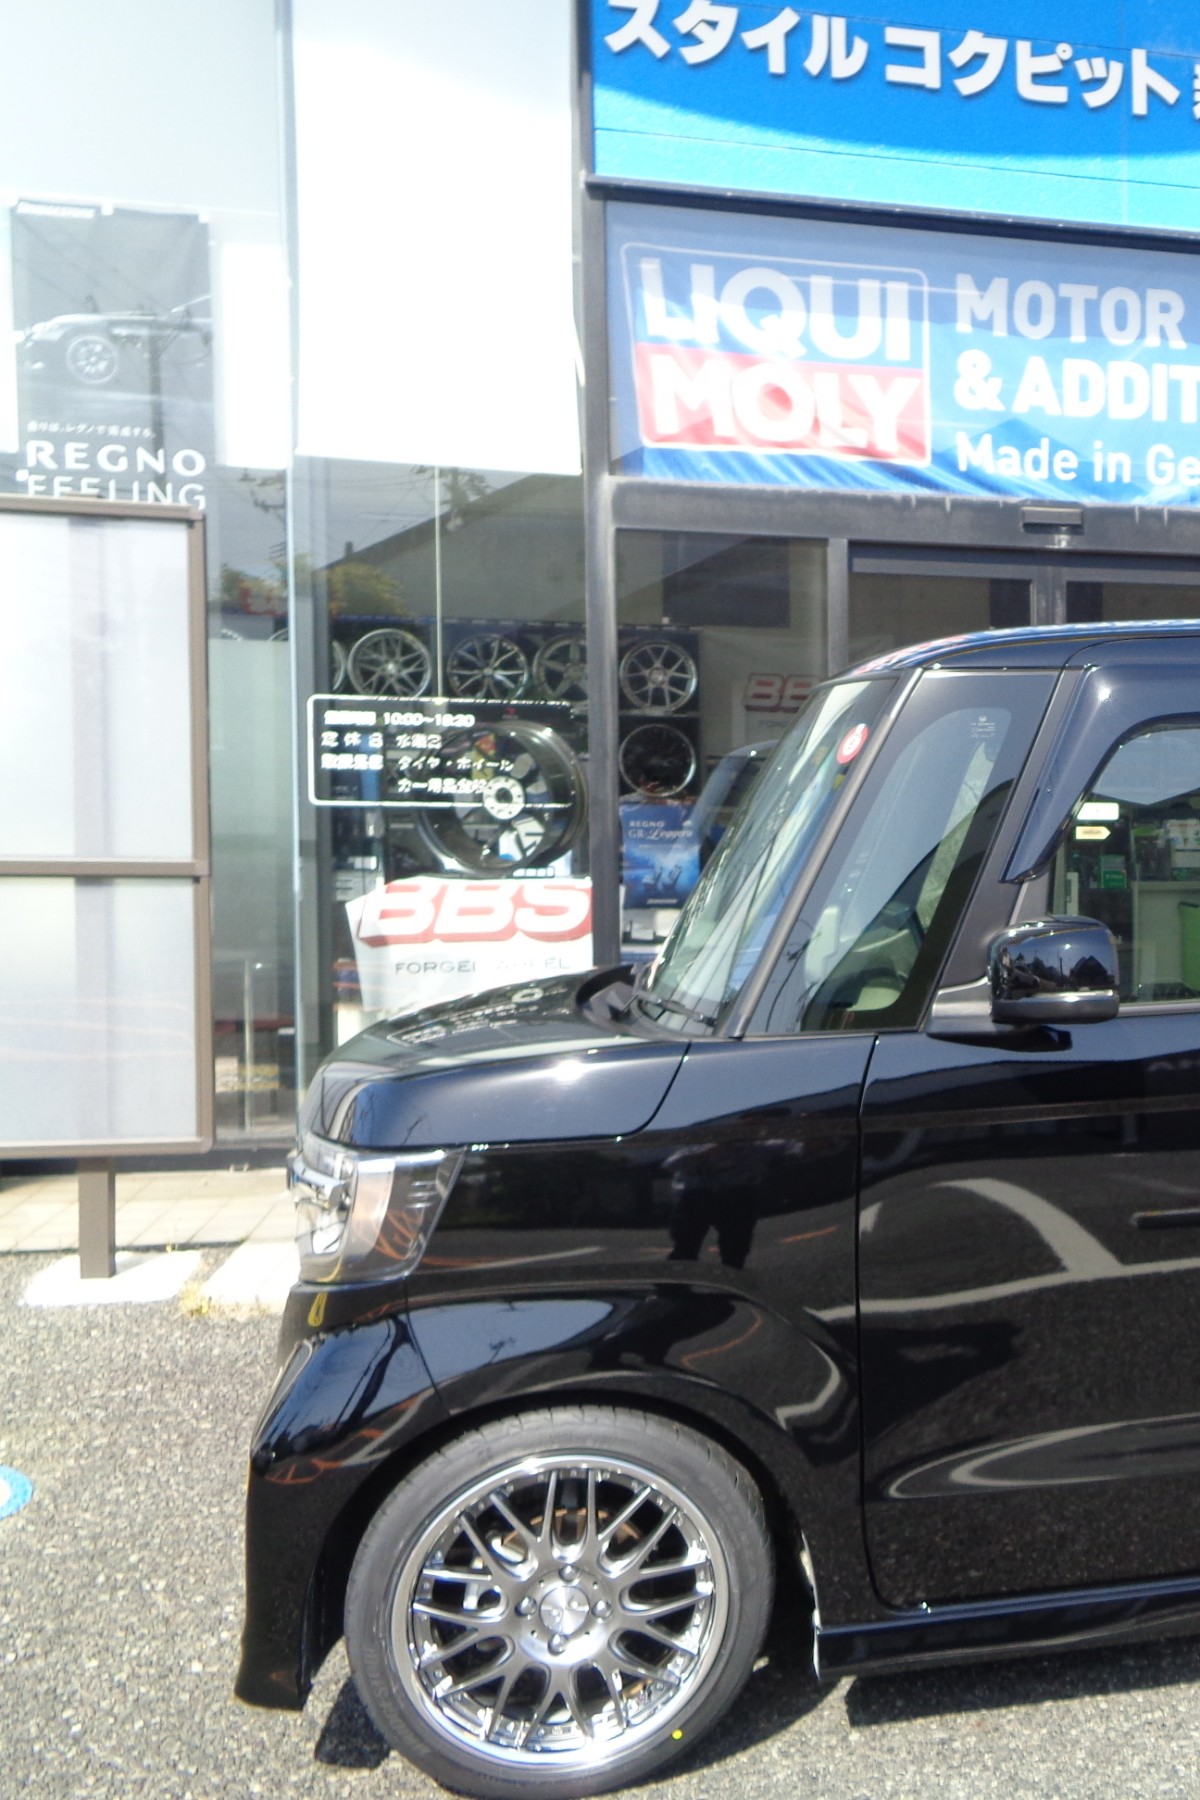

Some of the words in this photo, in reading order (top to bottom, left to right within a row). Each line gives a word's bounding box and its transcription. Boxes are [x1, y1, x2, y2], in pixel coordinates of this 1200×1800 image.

[640, 258, 911, 361] LIQUI
[955, 273, 1188, 350] MOTOR
[649, 354, 922, 451] MOLY
[953, 349, 1005, 412] &
[26, 440, 206, 477] REGNO
[956, 432, 1078, 481] Made
[1093, 441, 1132, 484] in
[743, 672, 822, 713] BB
[357, 878, 592, 947] BBS
[395, 959, 476, 974] FORGE
